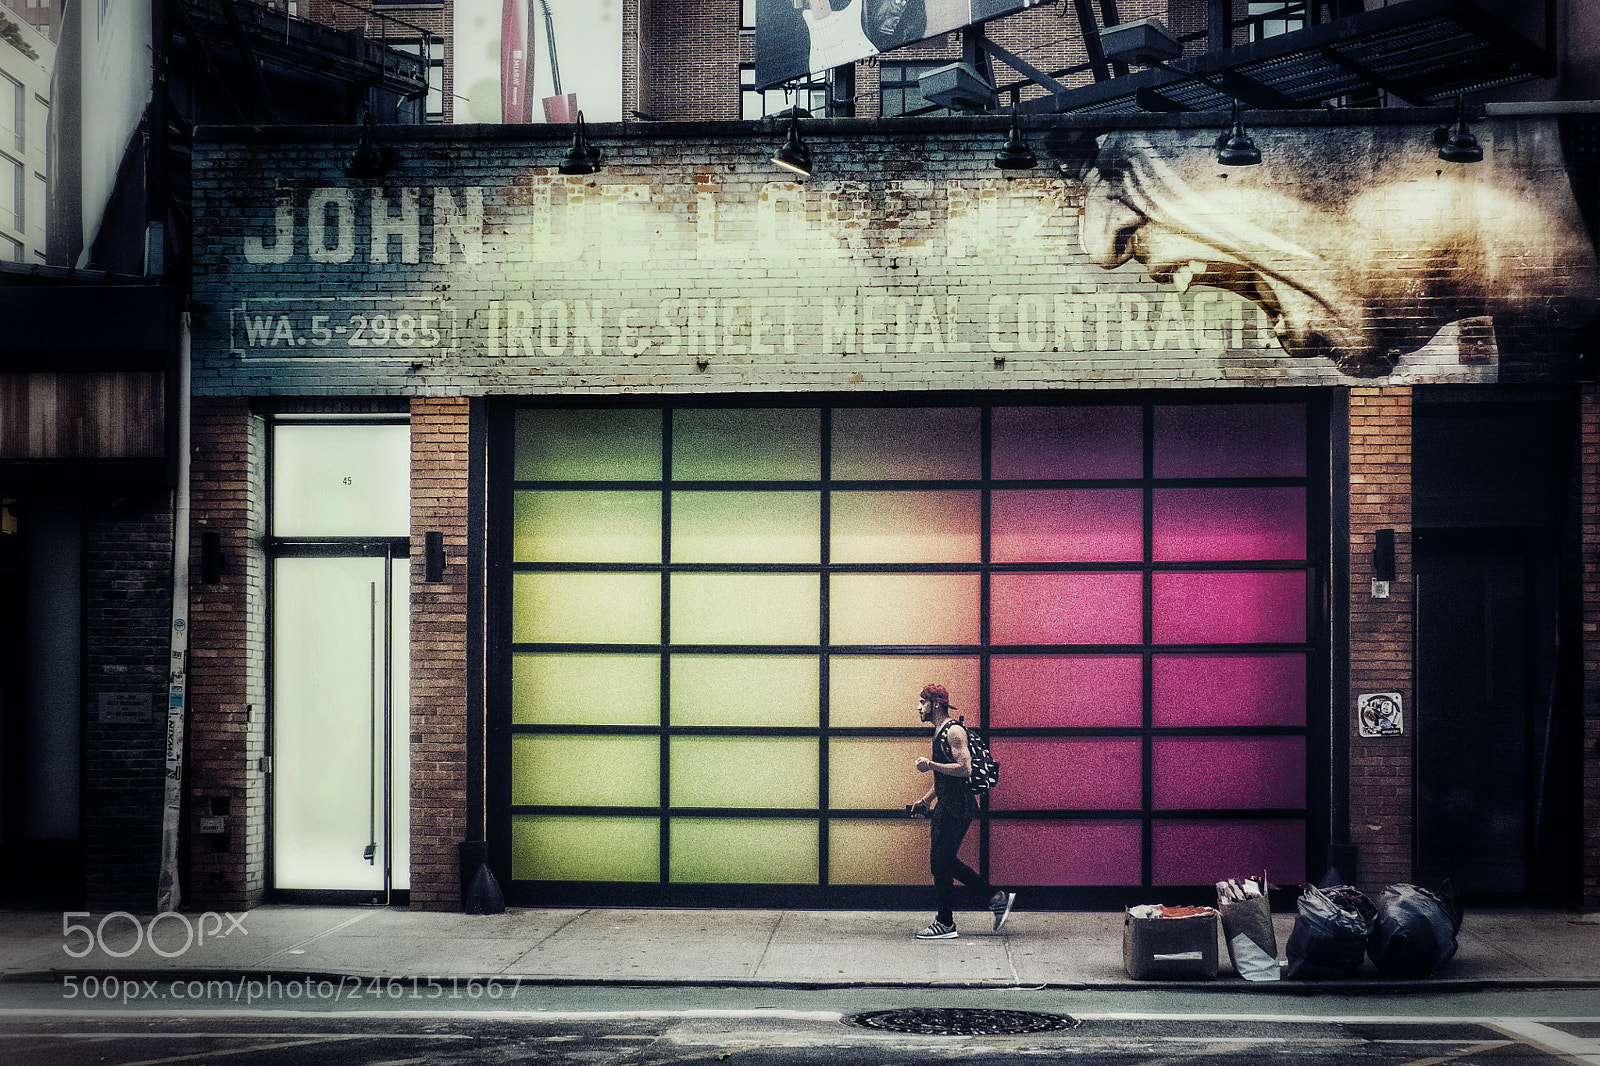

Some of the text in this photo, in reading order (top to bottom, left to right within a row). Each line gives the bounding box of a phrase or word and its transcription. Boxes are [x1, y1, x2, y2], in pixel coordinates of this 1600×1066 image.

[243, 175, 1090, 264] JOHN DE LORENZ
[244, 313, 442, 348] WA.5-2985
[488, 299, 603, 357] IRON
[619, 305, 658, 356] &
[659, 298, 795, 356] SHEET
[822, 296, 971, 354] METAL
[342, 476, 352, 486] 45
